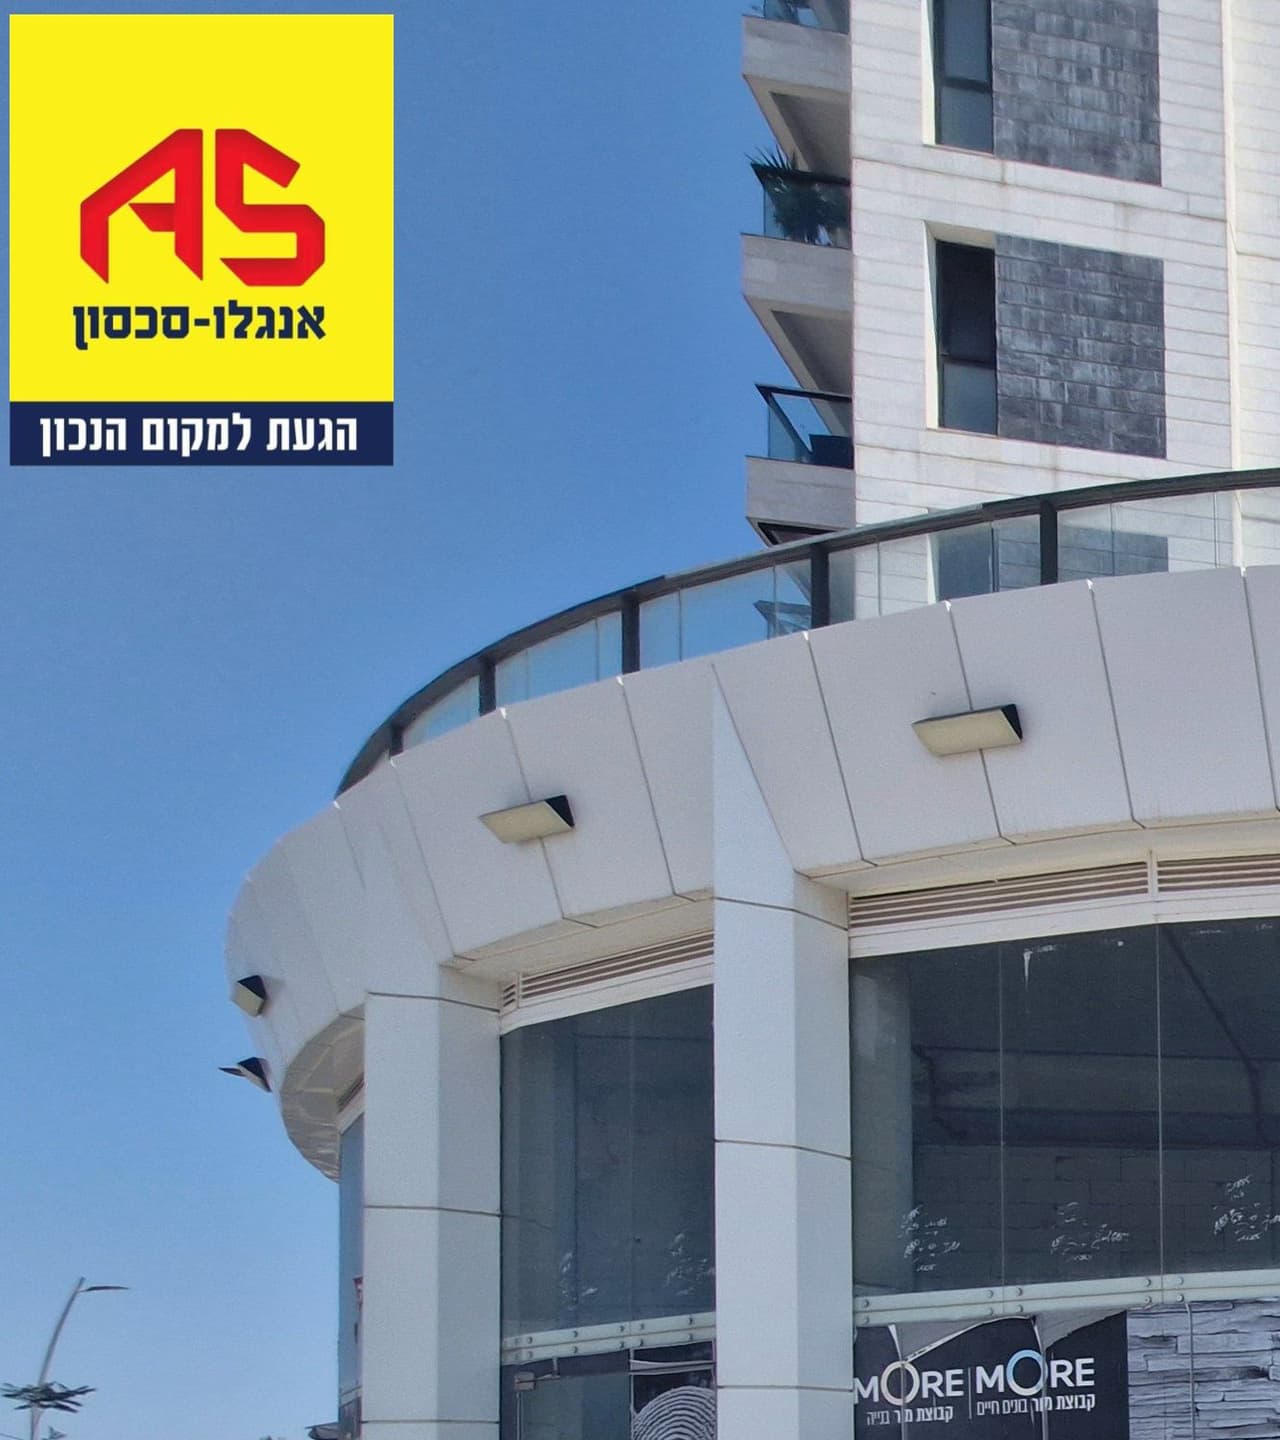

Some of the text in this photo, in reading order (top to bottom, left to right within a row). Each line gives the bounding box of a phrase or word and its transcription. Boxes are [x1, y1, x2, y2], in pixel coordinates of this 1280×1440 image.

[976, 1349, 1095, 1396] MORE
[853, 1361, 964, 1406] MORE
[976, 1401, 1000, 1416] חיים
[1002, 1399, 1028, 1414] בונים
[1056, 1394, 1096, 1412] קבוצת
[893, 1408, 913, 1424] מר
[916, 1406, 954, 1423] קבוצת
